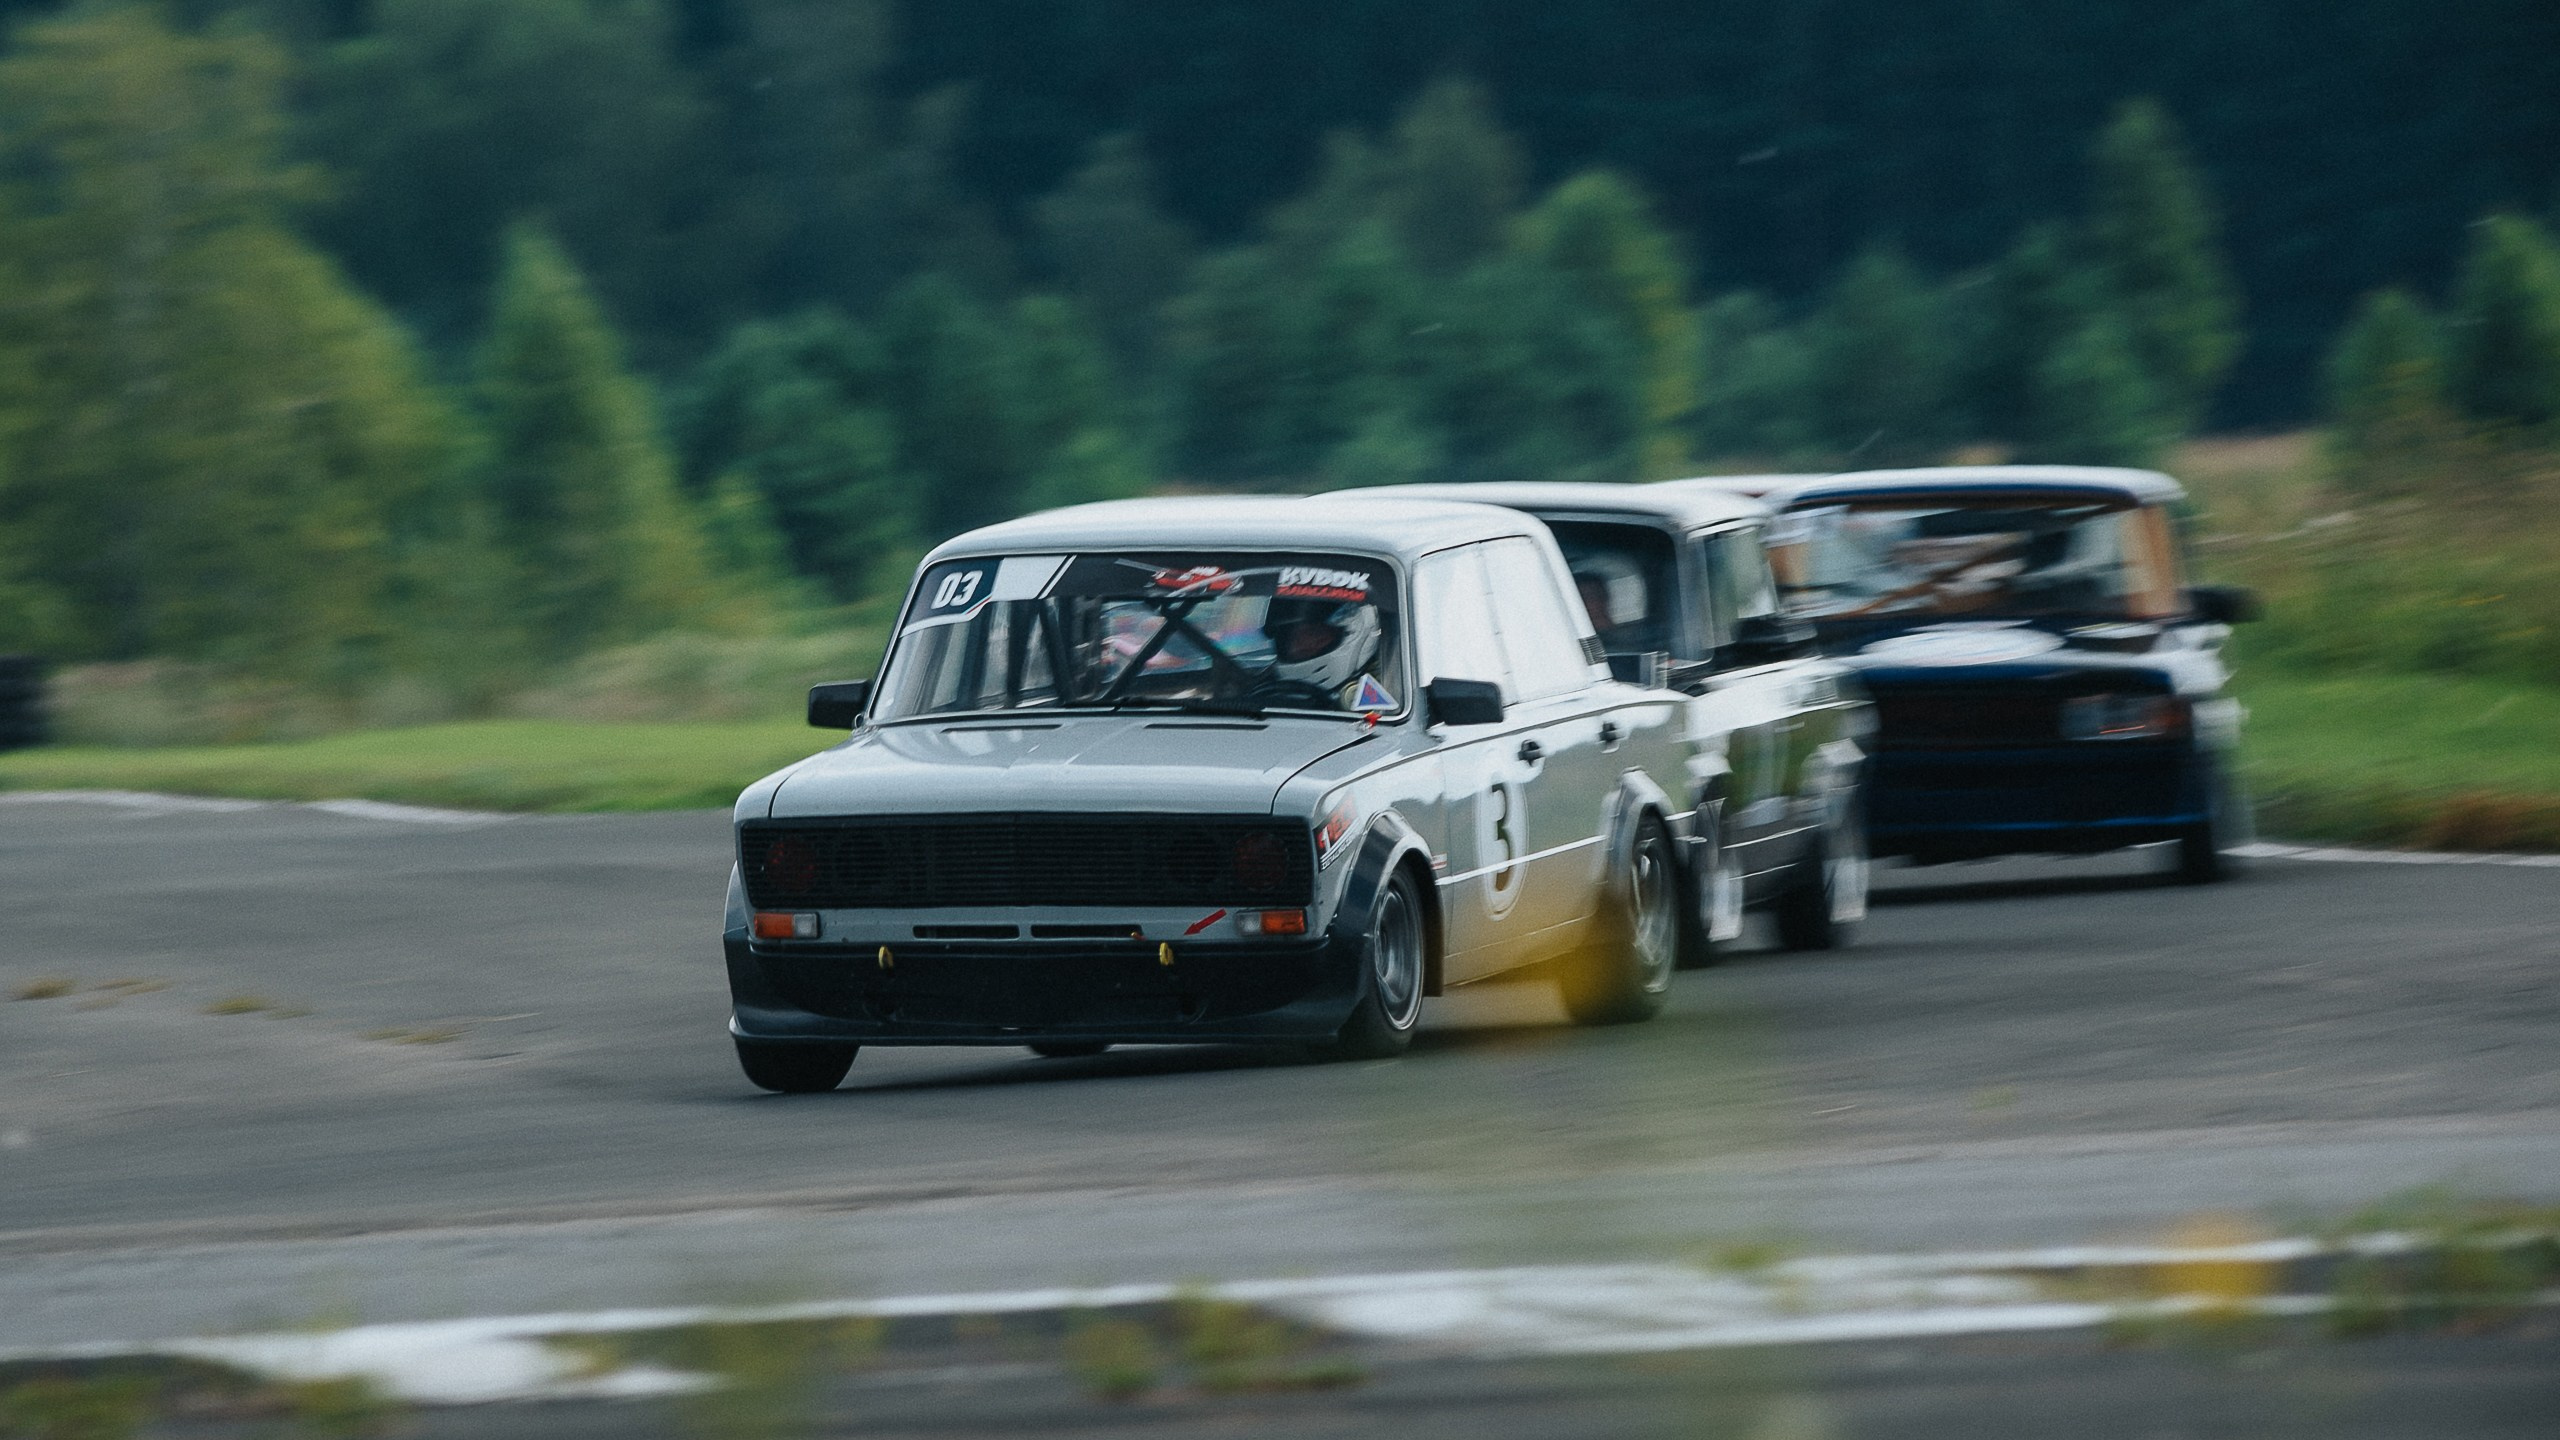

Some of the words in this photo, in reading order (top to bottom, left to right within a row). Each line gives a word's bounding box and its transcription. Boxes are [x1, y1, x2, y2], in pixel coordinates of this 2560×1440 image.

[931, 570, 983, 609] 03
[1278, 567, 1370, 590] КУБОК
[1491, 781, 1512, 892] 3
